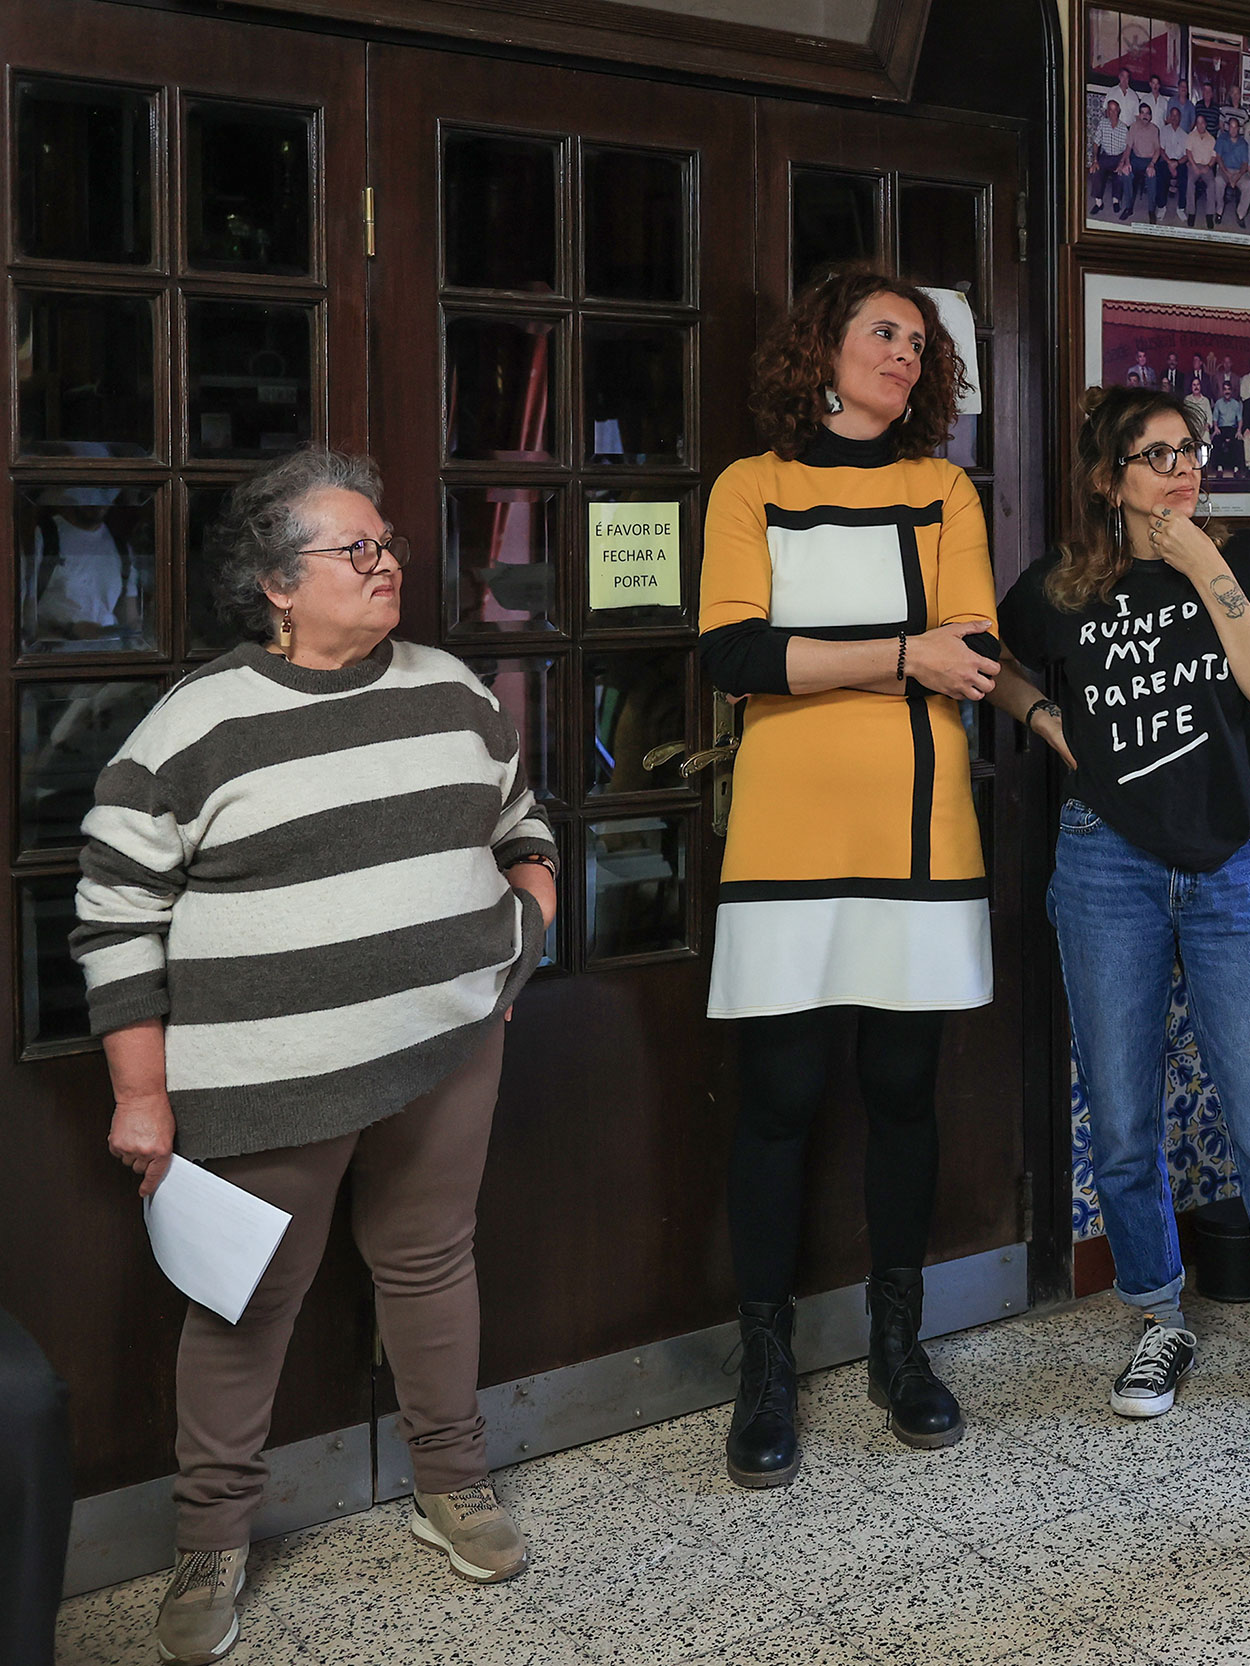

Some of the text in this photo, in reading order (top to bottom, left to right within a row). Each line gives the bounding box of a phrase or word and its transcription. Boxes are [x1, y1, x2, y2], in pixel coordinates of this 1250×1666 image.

[595, 521, 671, 536] É FAVOR DE
[603, 549, 666, 562] FECHAR A
[614, 574, 658, 588] PORTA
[1114, 593, 1132, 618] I
[1079, 601, 1199, 646] RUINED
[1104, 637, 1162, 670] MY
[1111, 704, 1194, 752] LIFE
